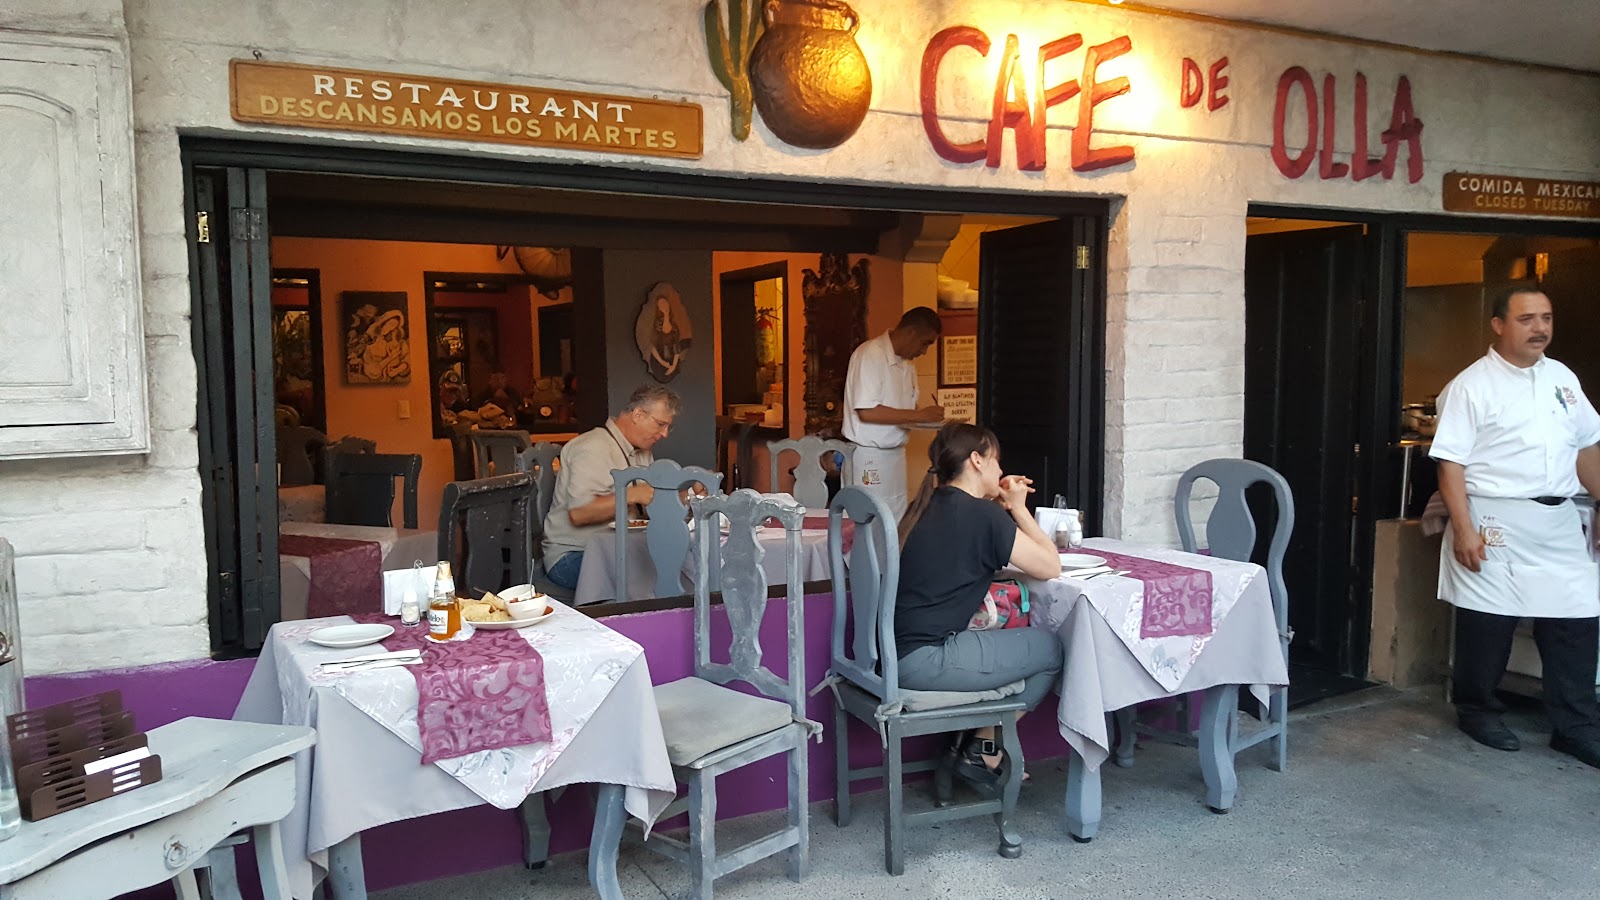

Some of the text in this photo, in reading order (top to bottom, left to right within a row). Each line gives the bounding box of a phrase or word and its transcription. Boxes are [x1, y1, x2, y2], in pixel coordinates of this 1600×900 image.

[260, 95, 678, 149] DESCANSAMOS LOS MARTES
[313, 74, 632, 123] RESTAURANT
[919, 25, 1425, 184] CAFE DE OLLA
[1459, 177, 1525, 195] COMIDA
[1475, 195, 1591, 212] CLOSED TUESDAY
